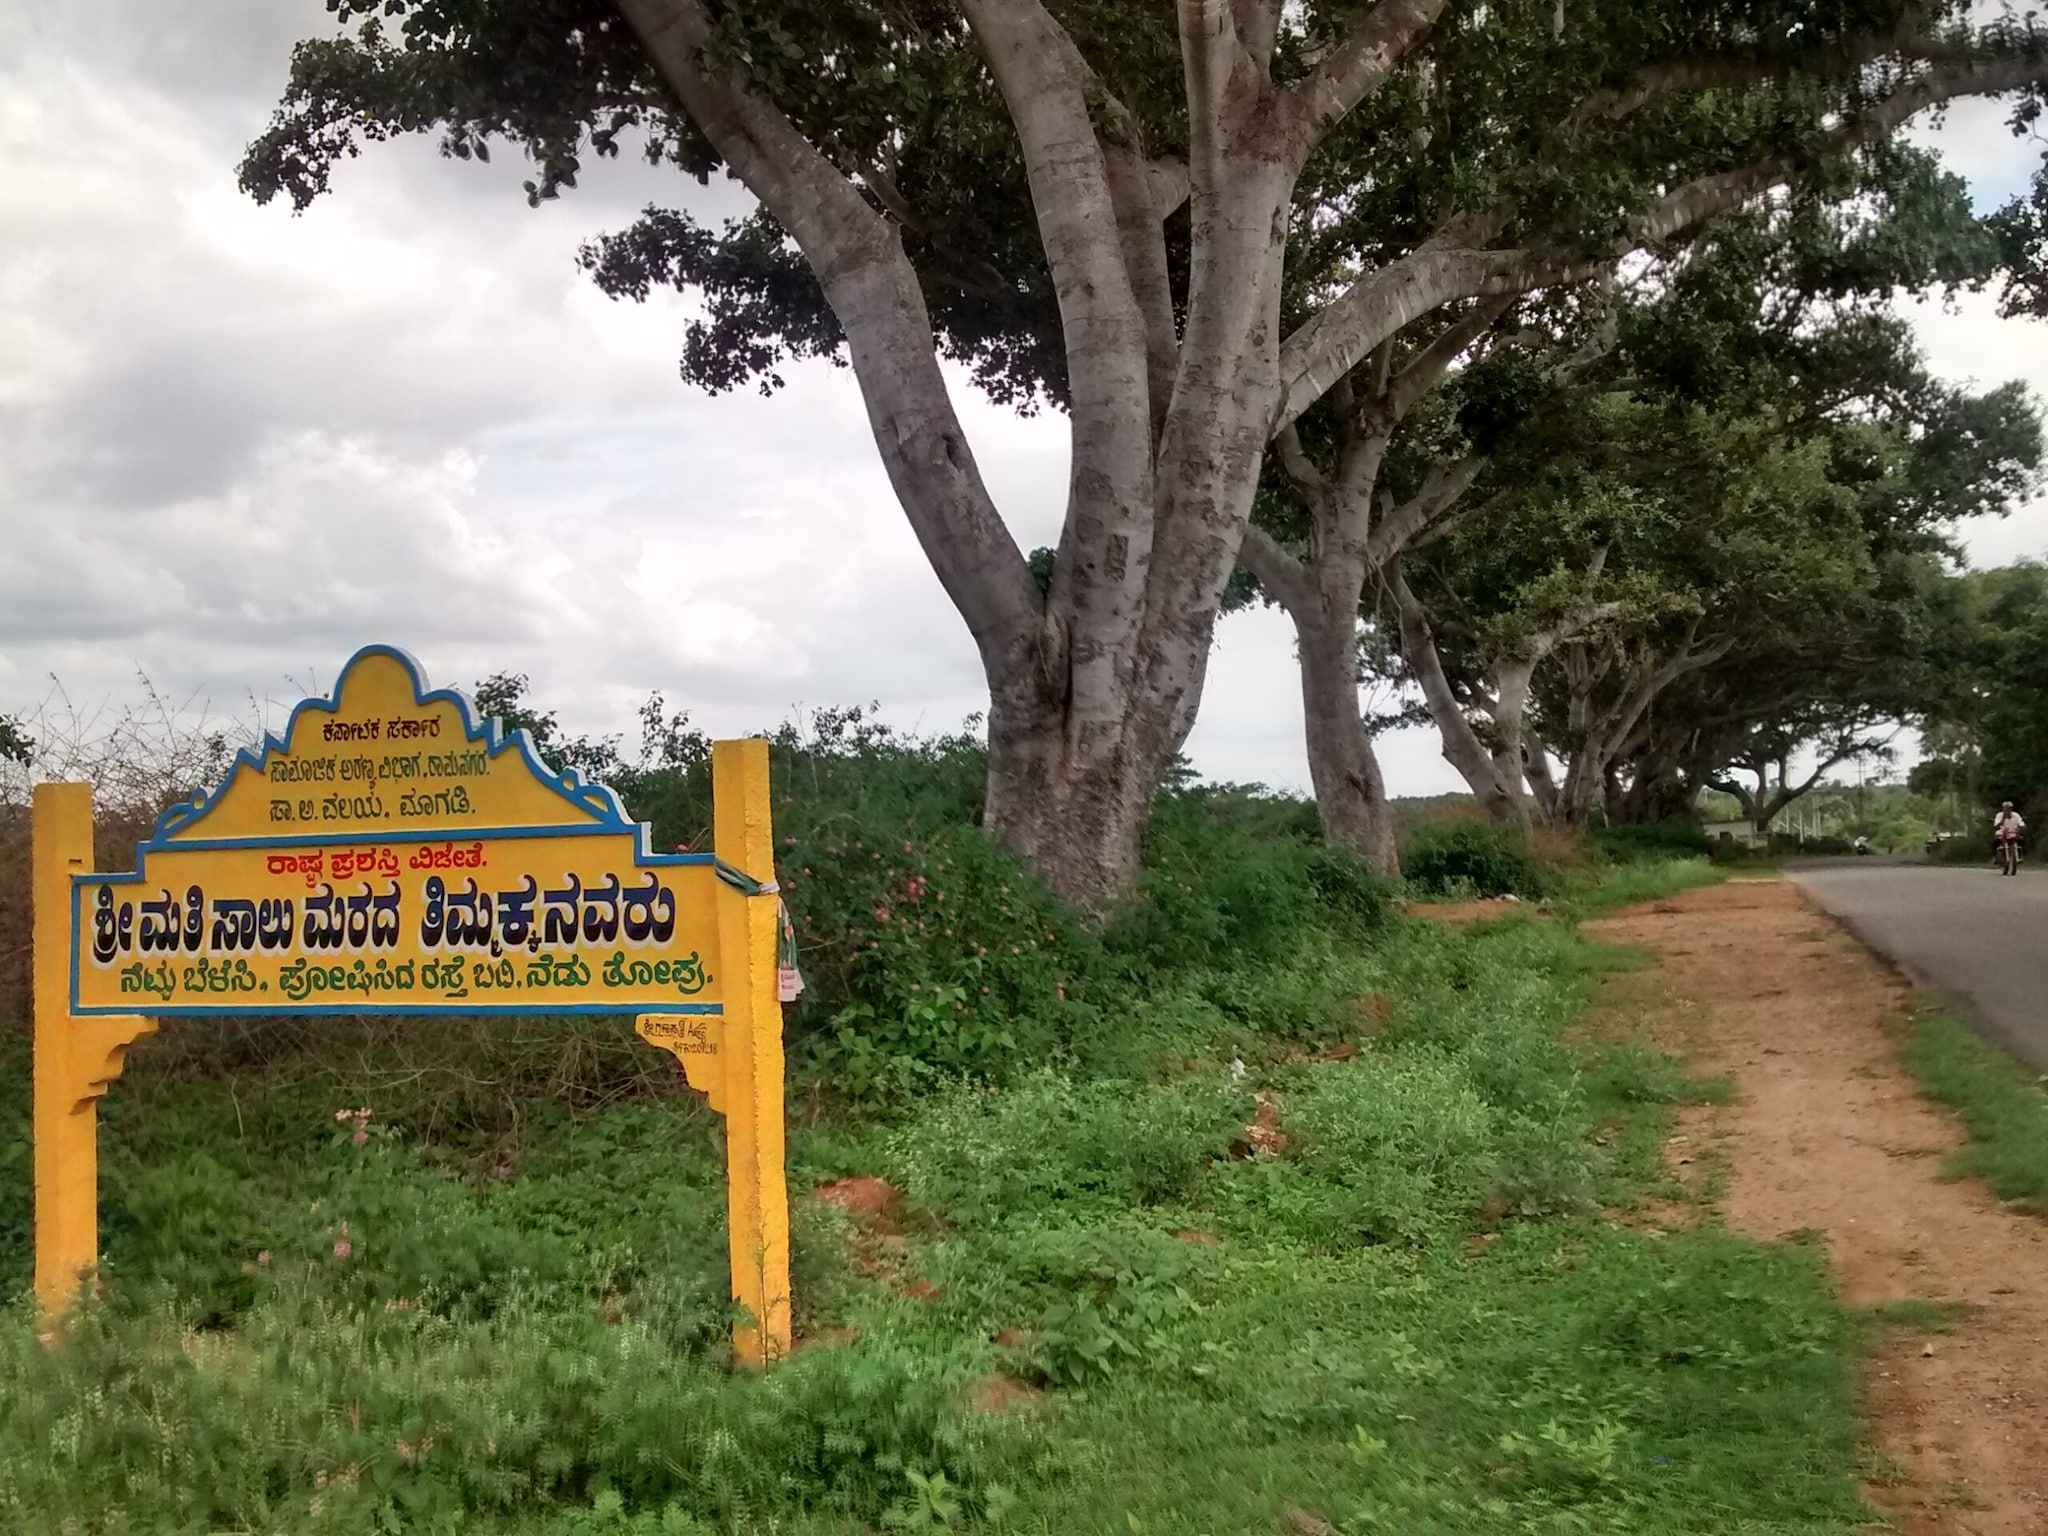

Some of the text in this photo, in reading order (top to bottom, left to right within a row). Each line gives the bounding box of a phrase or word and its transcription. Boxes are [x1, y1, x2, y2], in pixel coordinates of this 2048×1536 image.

[323, 715, 441, 742] ಕರ್ನಾಟಕ ಸರ್ಕಾರ
[270, 753, 337, 783] ಸಾಮಾಜಿಕ
[267, 848, 324, 888] ರಾಷ್ಟ್ರ
[331, 847, 402, 880] ಪ್ರಶಸ್ತಿ
[421, 871, 676, 957] ತಿಮ್ಮಕ್ಕನವರು
[120, 959, 177, 1000] ನೆಟ್ಟು
[279, 957, 415, 1000] ಪೋಷಿಸಿದ
[421, 955, 468, 998] ರಸ್ತೆ
[527, 953, 591, 987] ನೆಡು
